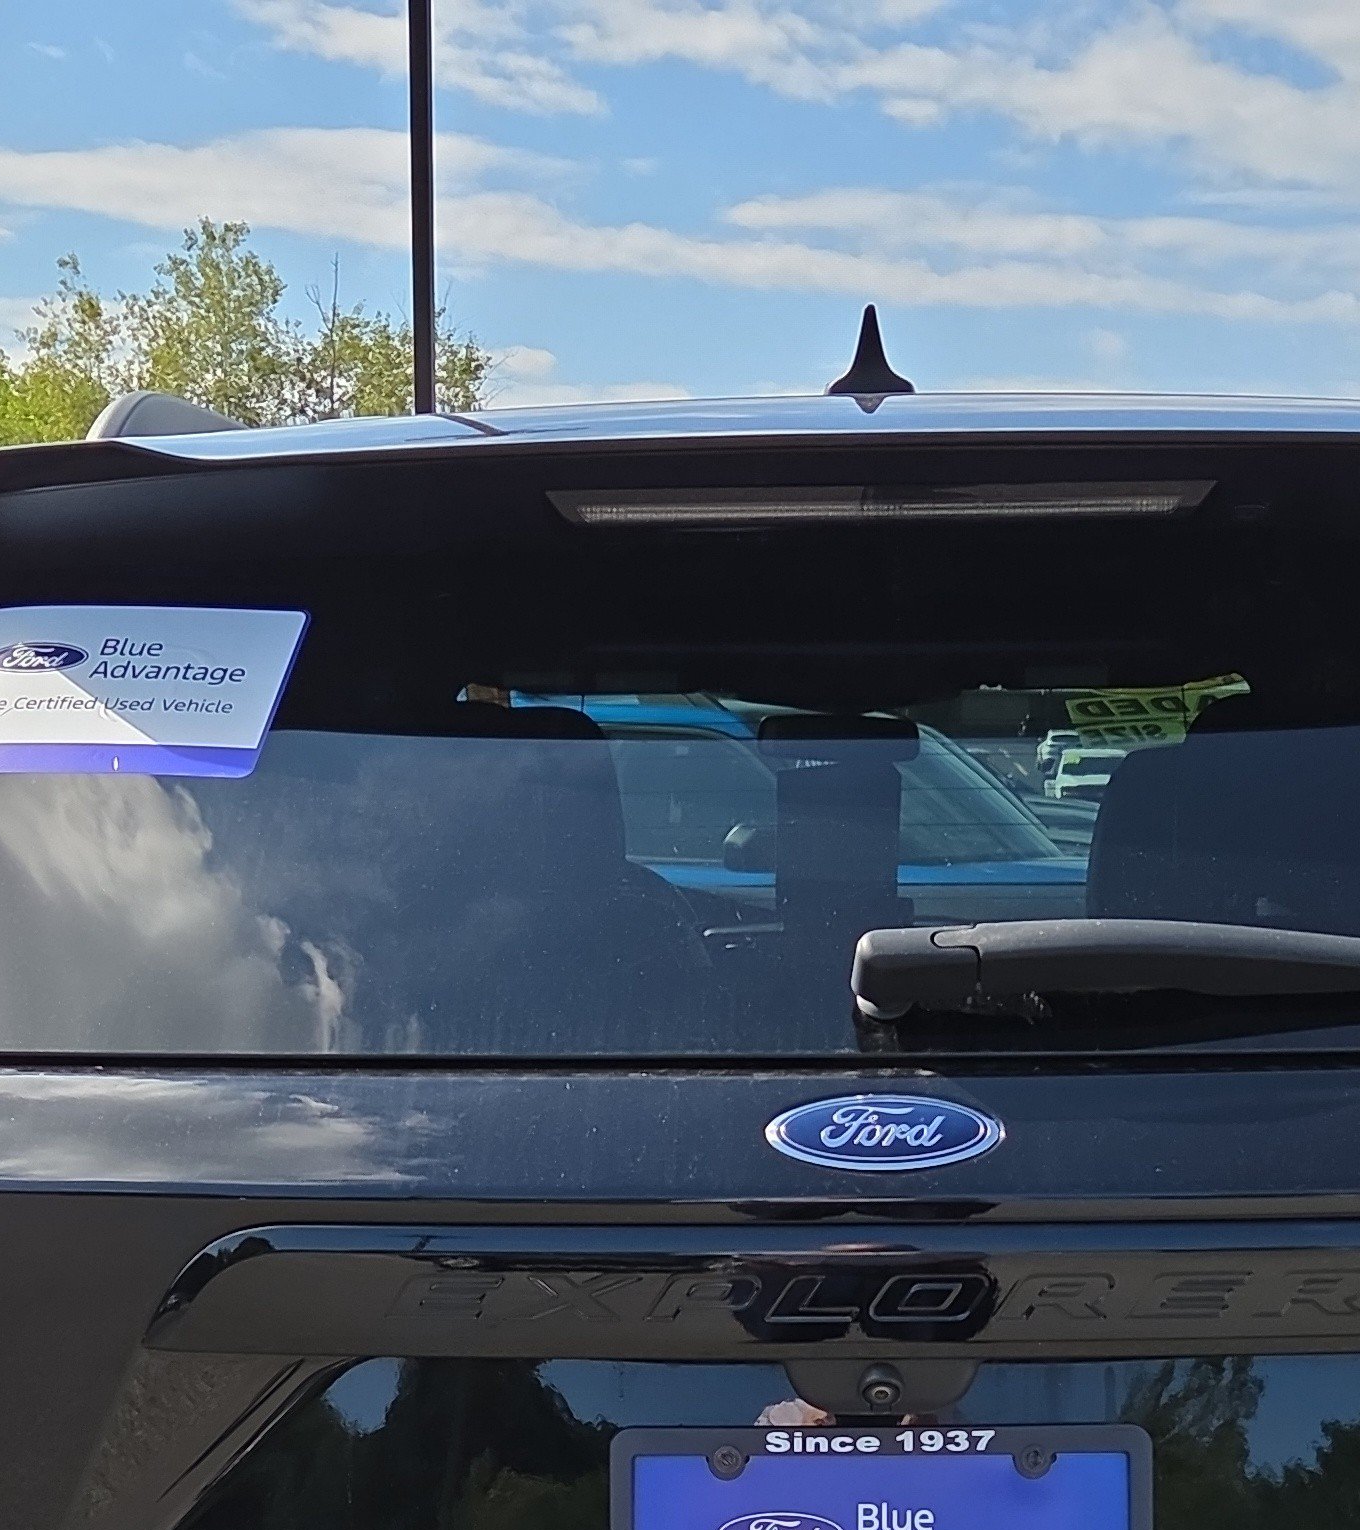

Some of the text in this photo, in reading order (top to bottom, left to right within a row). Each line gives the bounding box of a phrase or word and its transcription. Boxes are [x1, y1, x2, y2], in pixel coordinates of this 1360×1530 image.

[2, 646, 69, 668] Ford
[99, 637, 164, 657] Blue
[89, 660, 246, 686] Advantage
[13, 696, 98, 710] Certified
[104, 697, 156, 711] Used
[163, 698, 234, 714] Vehicle
[819, 1105, 946, 1149] Ford
[765, 1430, 996, 1453] Since 1937
